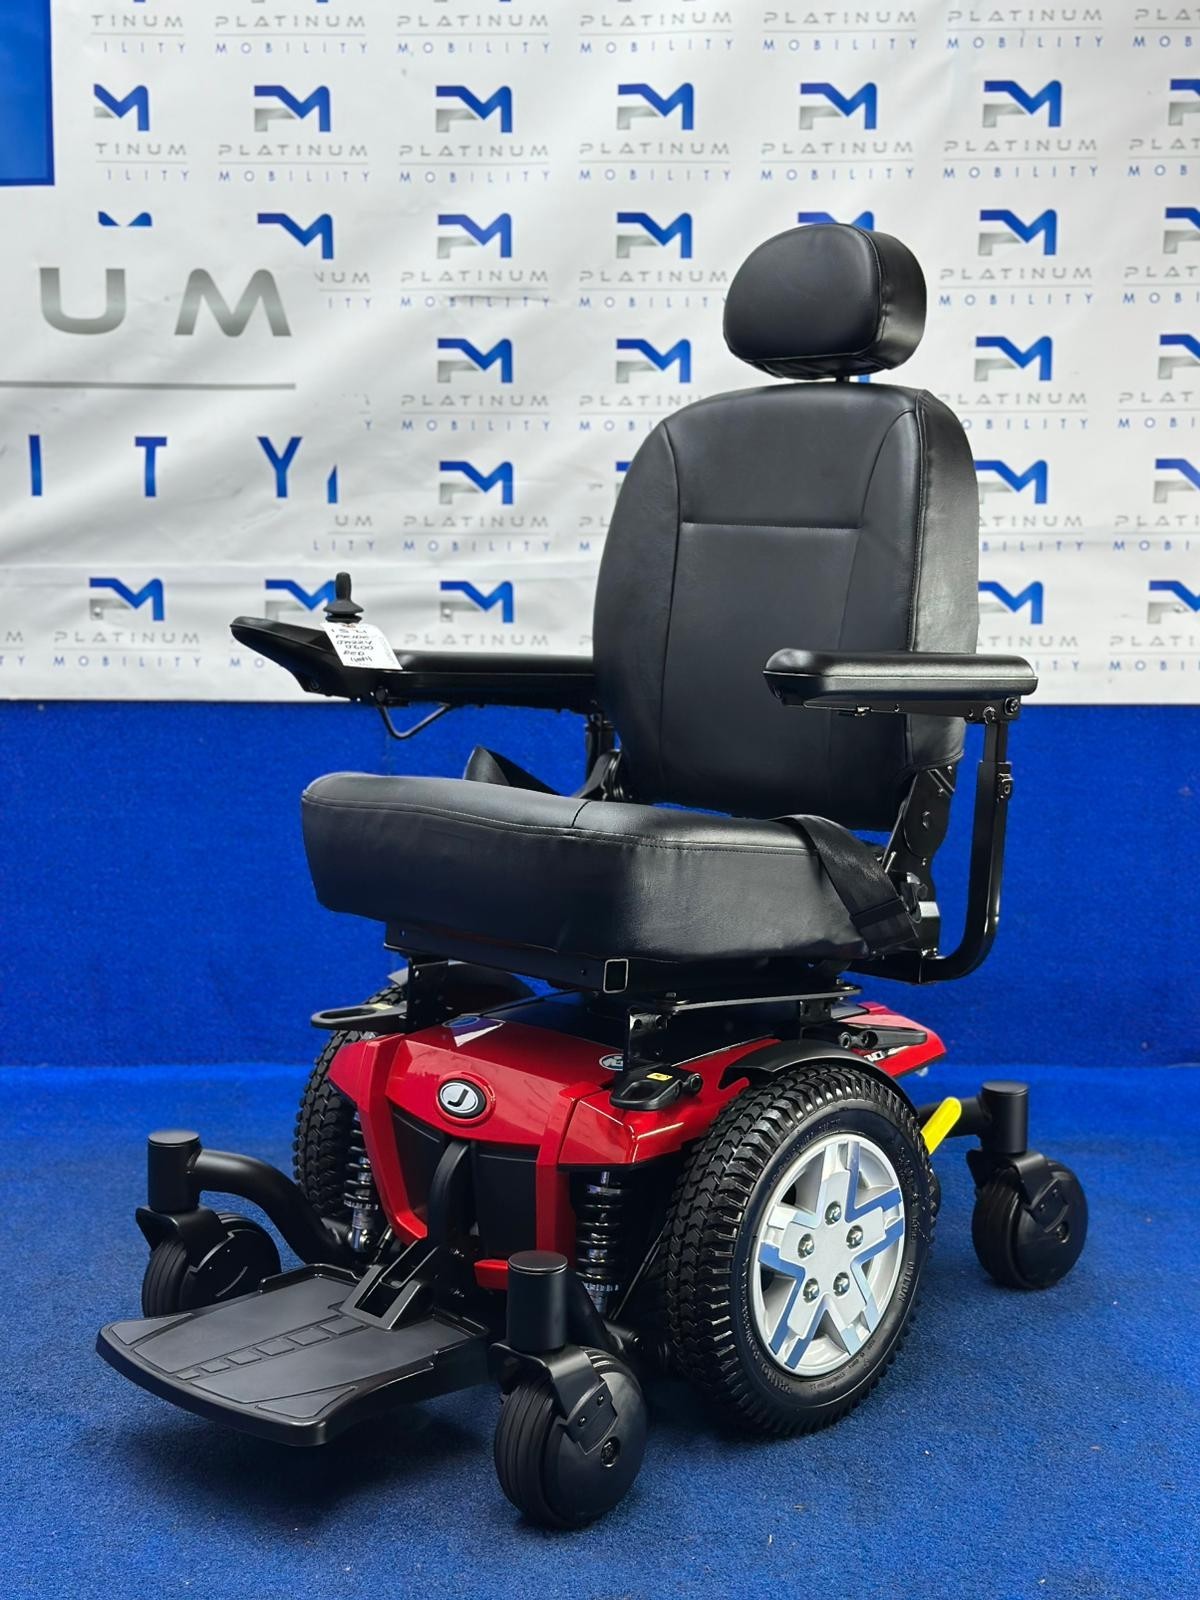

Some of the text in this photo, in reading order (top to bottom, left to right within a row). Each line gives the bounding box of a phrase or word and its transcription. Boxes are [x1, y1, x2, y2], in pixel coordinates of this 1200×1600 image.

[216, 15, 365, 27] PLATINUM
[397, 15, 548, 27] PLATINUM
[578, 12, 732, 27] PLATINUM
[763, 11, 916, 24] PLATINUM
[948, 9, 1102, 22] PLATINUM
[216, 42, 366, 54] MOBILITY
[579, 38, 733, 53] MOBILITY
[763, 38, 917, 51] MOBILITY
[948, 36, 1103, 48] MOBILITY
[398, 42, 549, 55] MOBILITY
[218, 144, 367, 156] PLATINUM
[399, 145, 547, 157] PLATINUM
[580, 142, 729, 155] PLATINUM
[761, 142, 912, 154] PLATINUM
[944, 139, 1097, 152] PLATINUM
[219, 171, 369, 182] MOBILITY
[399, 171, 548, 183] MOBILITY
[580, 169, 730, 181] MOBILITY
[761, 168, 914, 180] MOBILITY
[943, 166, 1098, 178] MOBILITY
[401, 270, 550, 283] PLATINUM
[579, 266, 727, 282] PLATINUM
[940, 267, 1092, 280] PLATINUM
[38, 267, 292, 338] UM
[401, 294, 550, 307] MOBILITY
[939, 293, 1092, 305] MOBILITY
[401, 394, 547, 406] PLATINUM
[401, 419, 549, 431] MOBILITY
[28, 433, 303, 500] ITY
[404, 514, 548, 528] PLATINUM
[403, 540, 549, 552] MOBILITY
[52, 632, 202, 644] PLATINUM
[404, 633, 549, 644] PLATINUM
[53, 656, 200, 667] MOBILITY
[1109, 661, 1200, 671] MOBI
